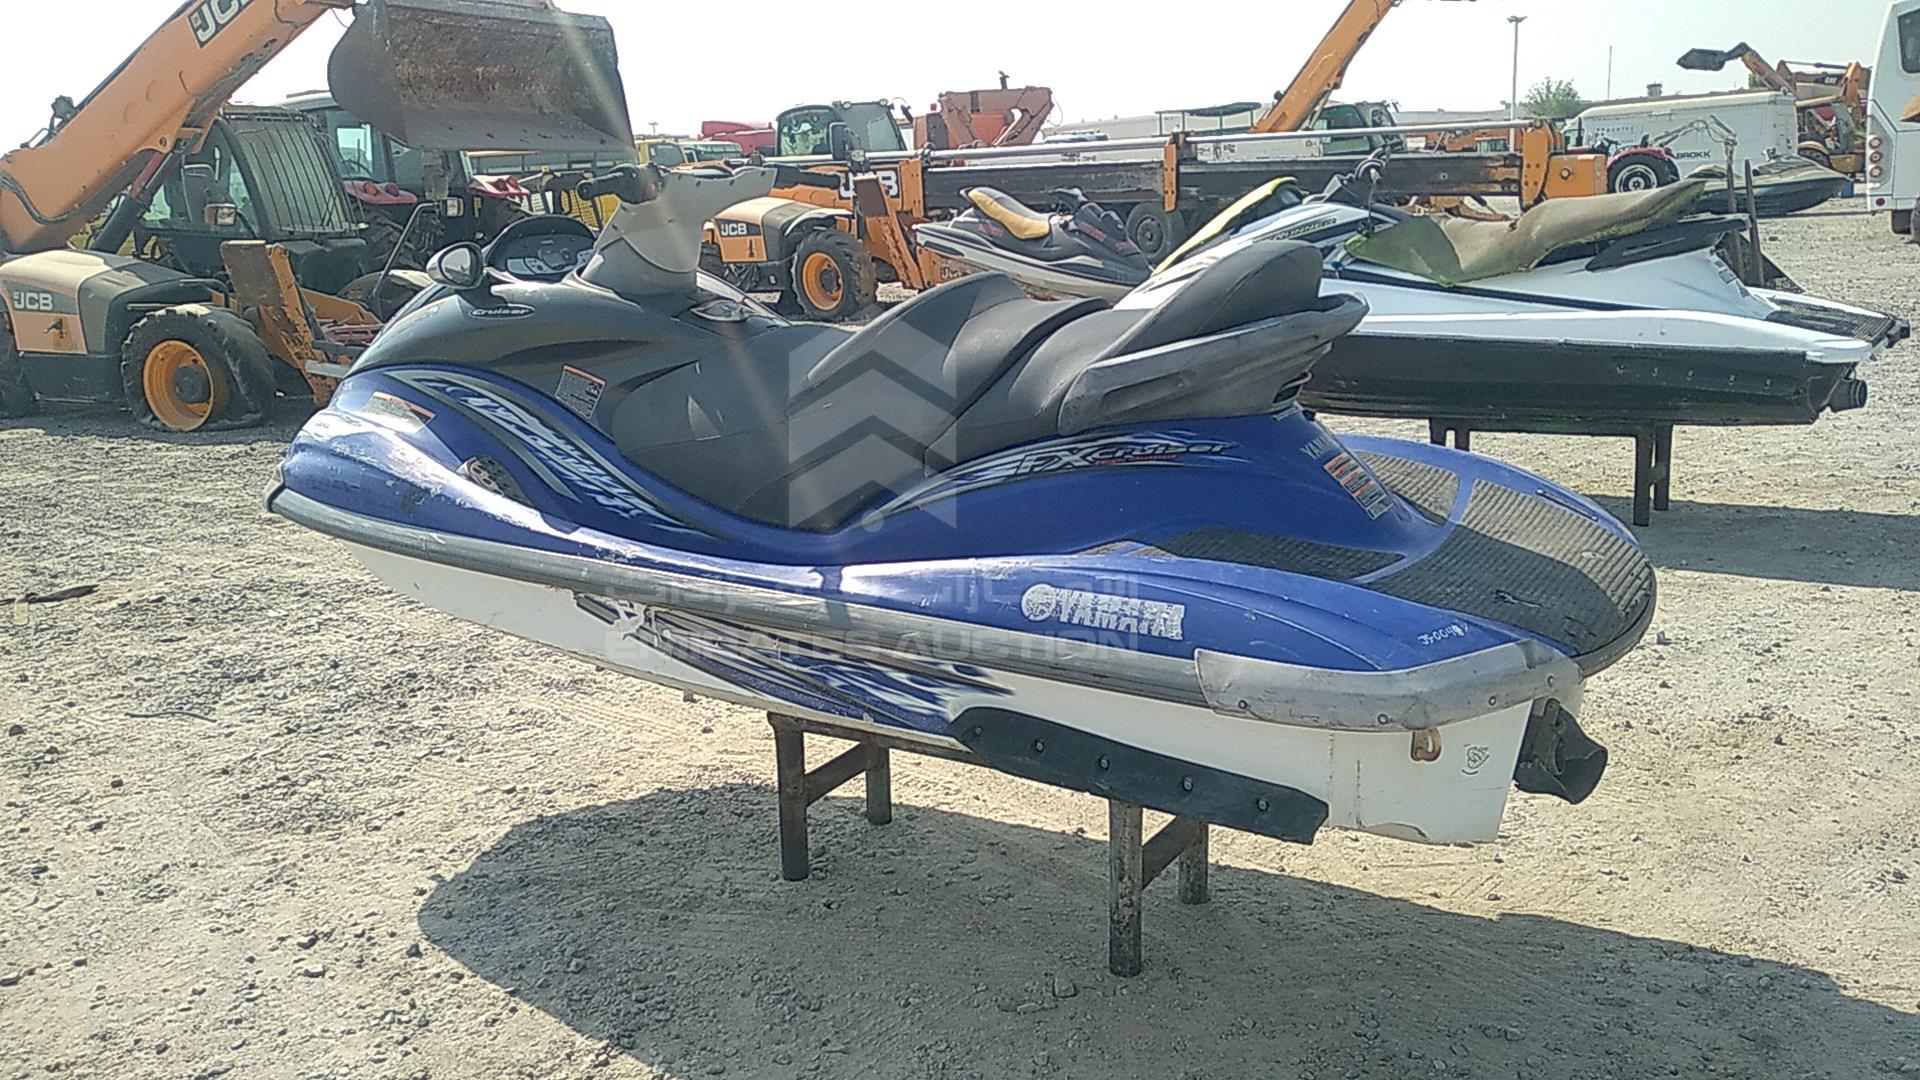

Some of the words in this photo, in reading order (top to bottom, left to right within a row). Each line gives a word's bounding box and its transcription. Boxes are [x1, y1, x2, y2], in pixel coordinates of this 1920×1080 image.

[190, 0, 251, 41] JC
[839, 169, 898, 198] JB
[721, 223, 747, 235] JCB
[13, 291, 53, 311] JCB
[1018, 448, 1094, 475] FX
